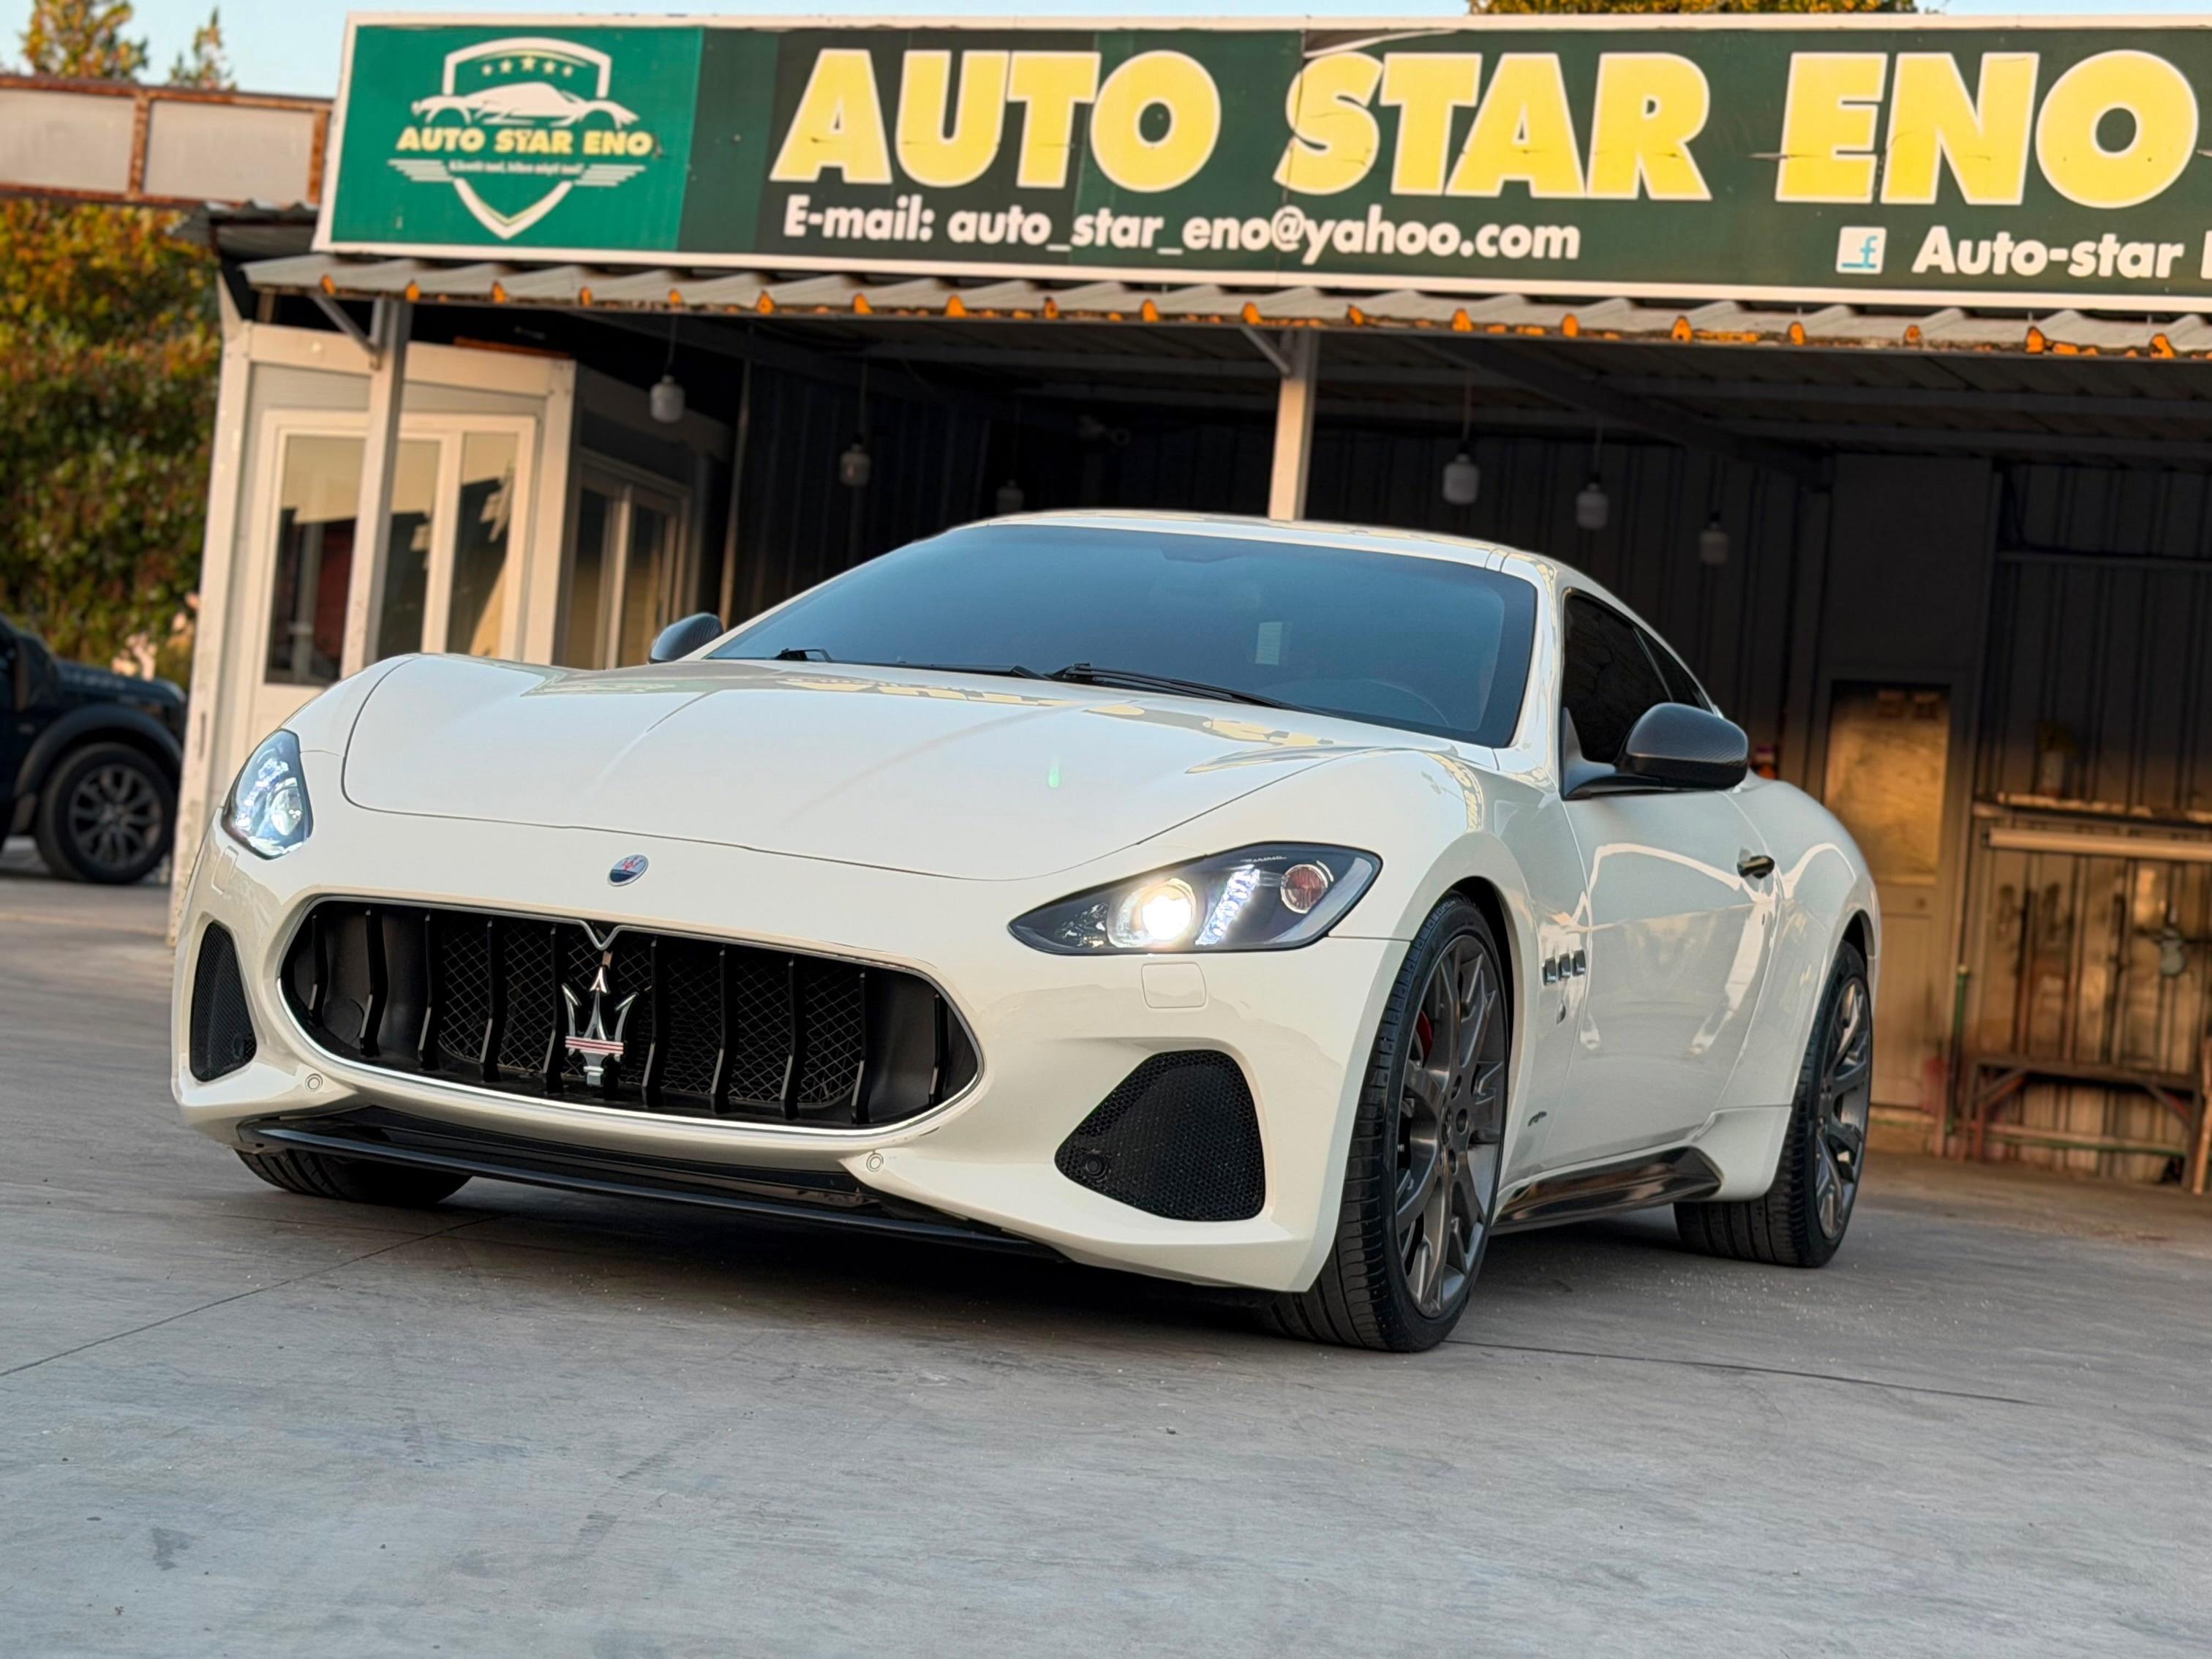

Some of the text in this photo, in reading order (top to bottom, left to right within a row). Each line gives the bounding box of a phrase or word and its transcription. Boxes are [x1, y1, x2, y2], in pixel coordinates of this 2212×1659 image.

[396, 127, 653, 156] AUTO STAR ENO
[769, 48, 2199, 209] AUTO STAR ENO
[783, 195, 1580, 265] E-mail: auto_star_eno@yahoo.com
[1911, 225, 2185, 279] Auto-star
